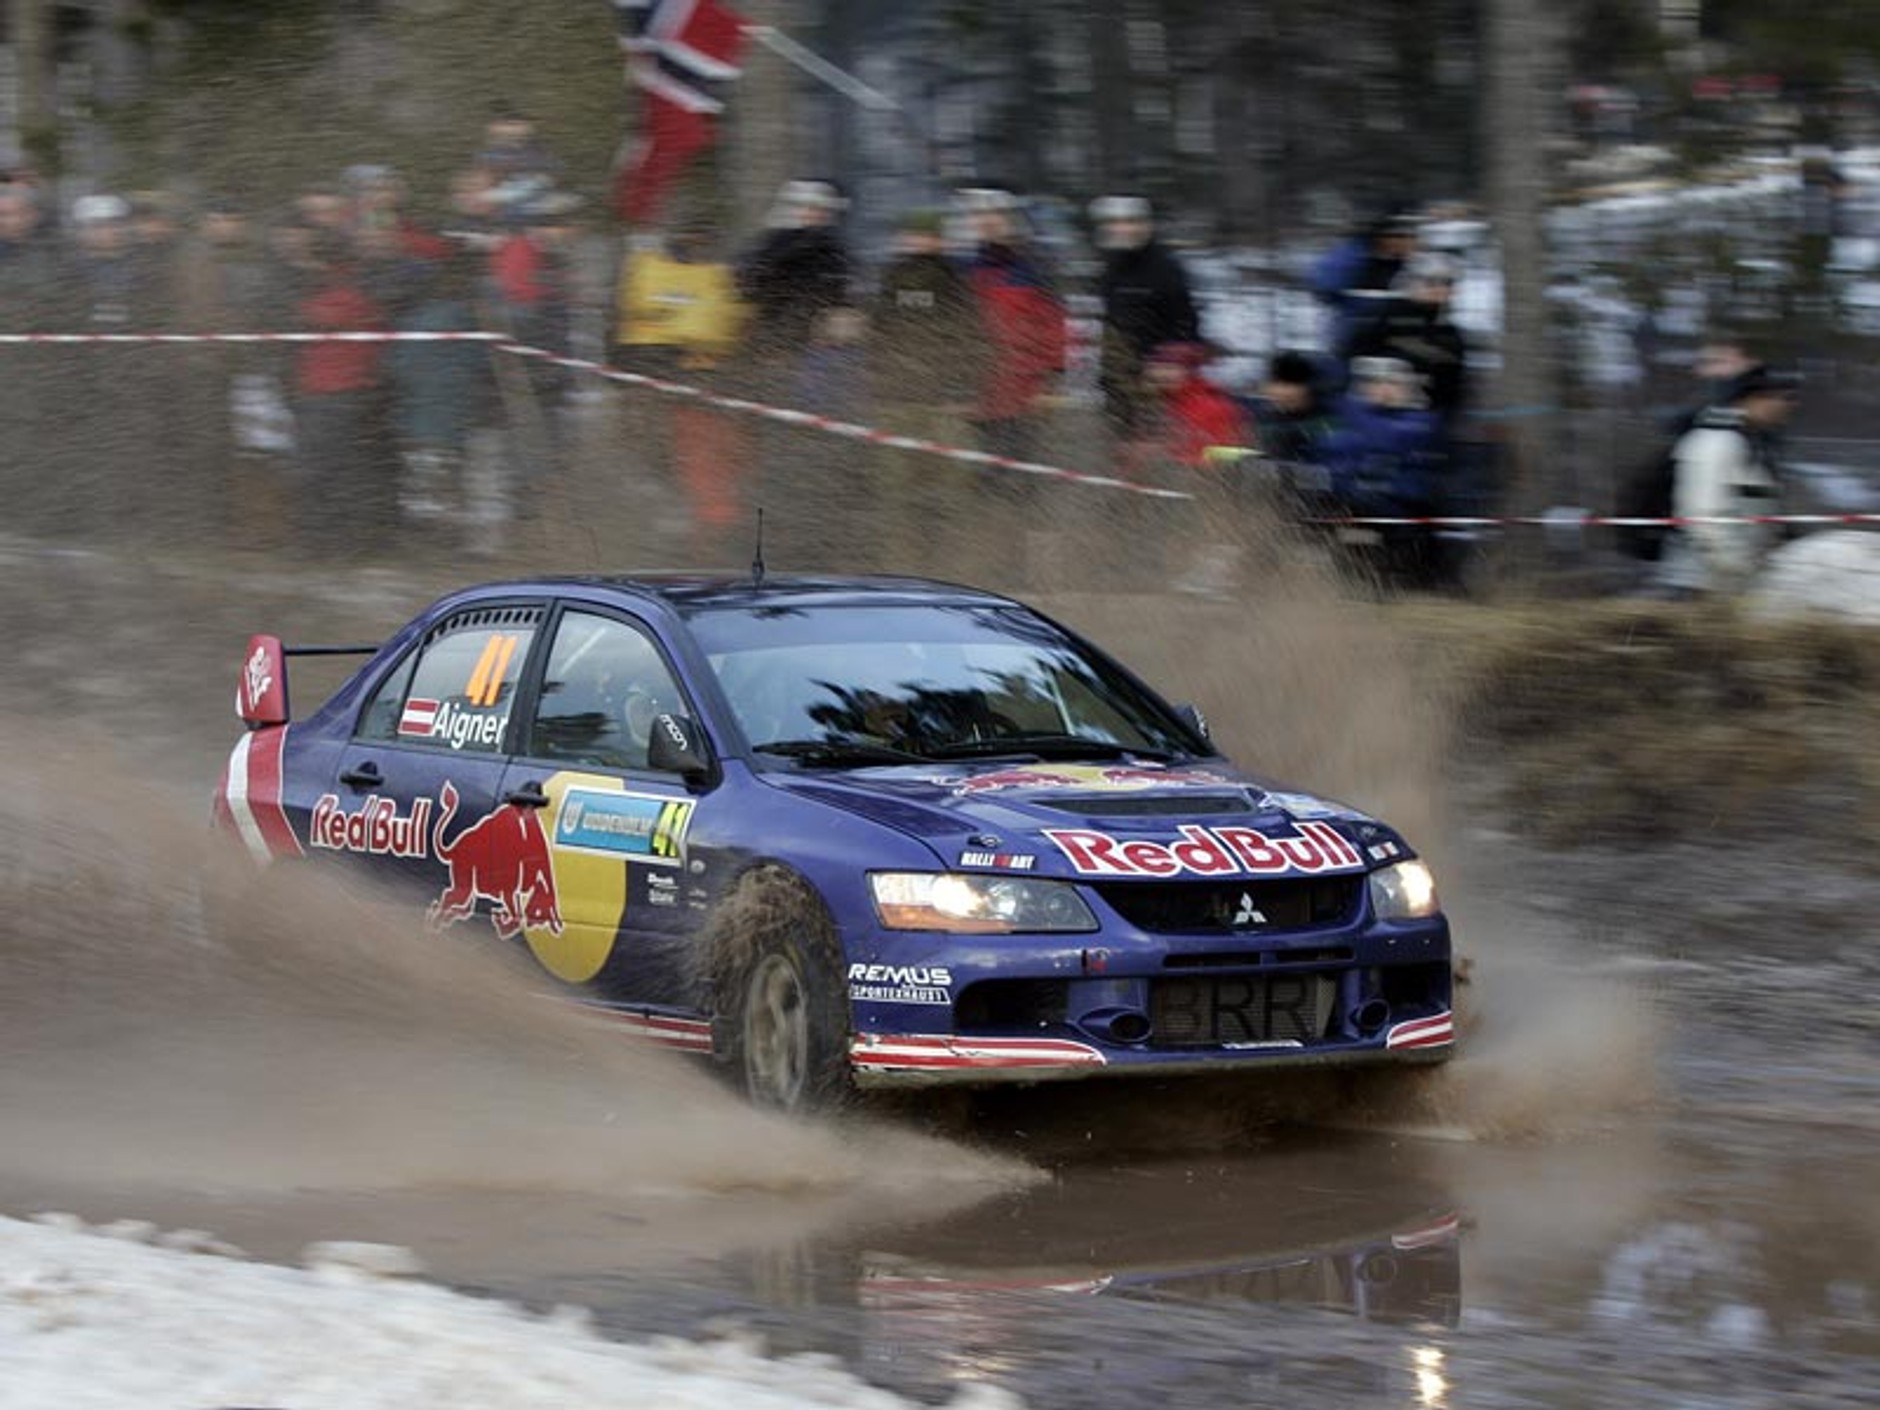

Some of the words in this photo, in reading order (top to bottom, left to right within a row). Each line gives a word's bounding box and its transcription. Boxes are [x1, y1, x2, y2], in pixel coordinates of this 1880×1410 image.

[435, 701, 509, 750] Aigner
[848, 963, 952, 986] REMUS
[1160, 974, 1313, 1043] BRR
